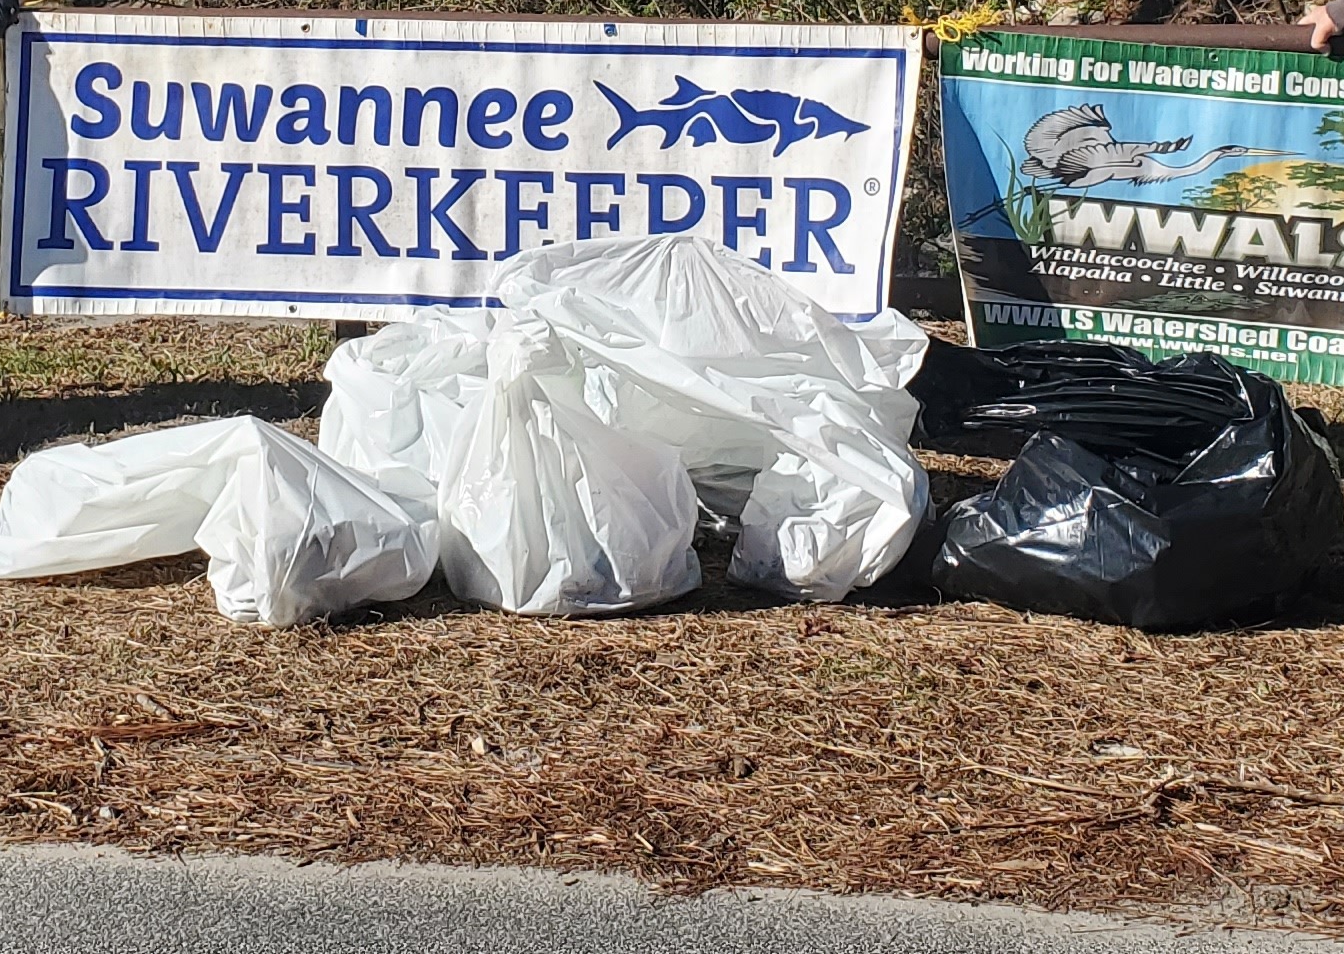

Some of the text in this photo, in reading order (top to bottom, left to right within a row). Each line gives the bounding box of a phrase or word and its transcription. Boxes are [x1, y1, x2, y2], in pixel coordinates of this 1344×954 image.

[962, 48, 1074, 82] Working
[1080, 57, 1123, 83] For
[1129, 60, 1280, 96] Watershed
[70, 62, 573, 150] Suwannee
[37, 157, 856, 275] RIVERKEEPER
[1029, 246, 1206, 275] Withlacoochee
[1029, 262, 1132, 284] Alapaha
[1158, 273, 1226, 292] Little
[984, 303, 1094, 331] WWALS
[1101, 309, 1279, 351] Watershed
